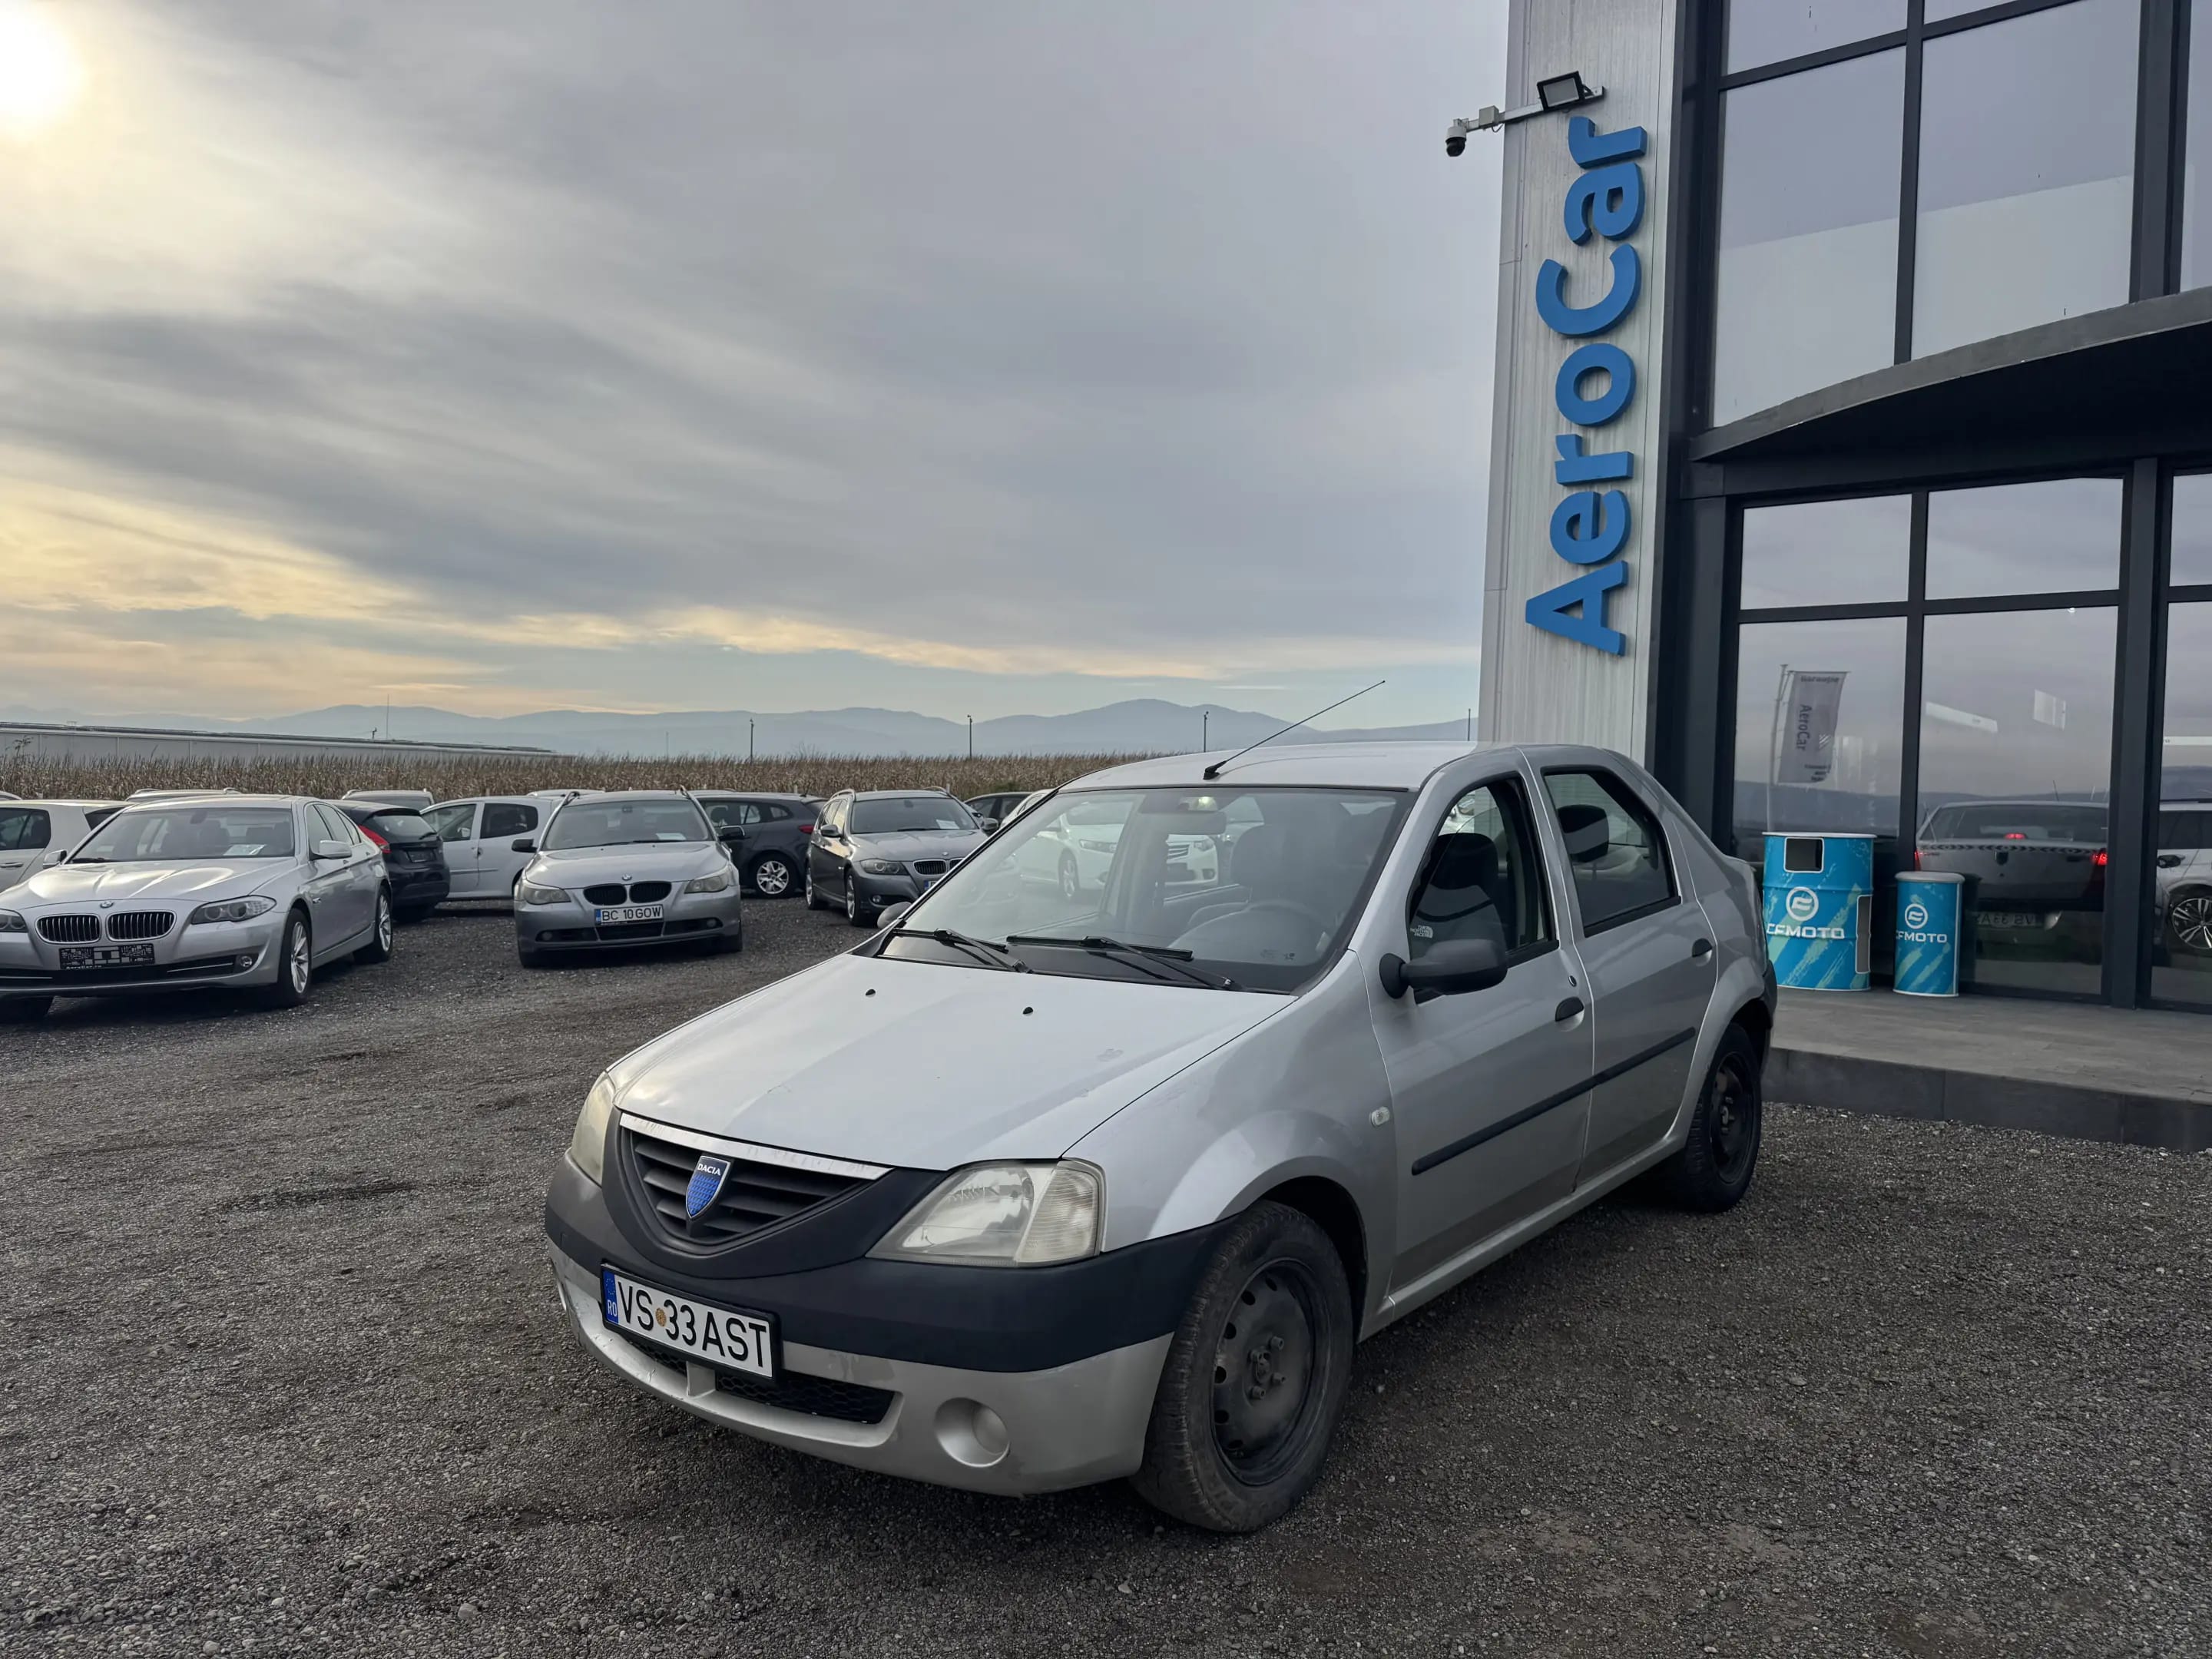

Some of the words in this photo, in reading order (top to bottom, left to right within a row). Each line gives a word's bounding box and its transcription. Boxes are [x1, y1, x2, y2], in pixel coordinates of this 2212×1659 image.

[1525, 116, 1647, 658] AeroCar
[601, 910, 618, 921] BC
[623, 909, 634, 919] 10
[635, 907, 661, 919] GOW
[1766, 923, 1845, 939] CFMOTO
[697, 1163, 721, 1176] DACIA
[607, 1300, 618, 1318] RO
[618, 1281, 654, 1331] VS
[664, 1300, 697, 1346] 33
[701, 1311, 767, 1368] AST
